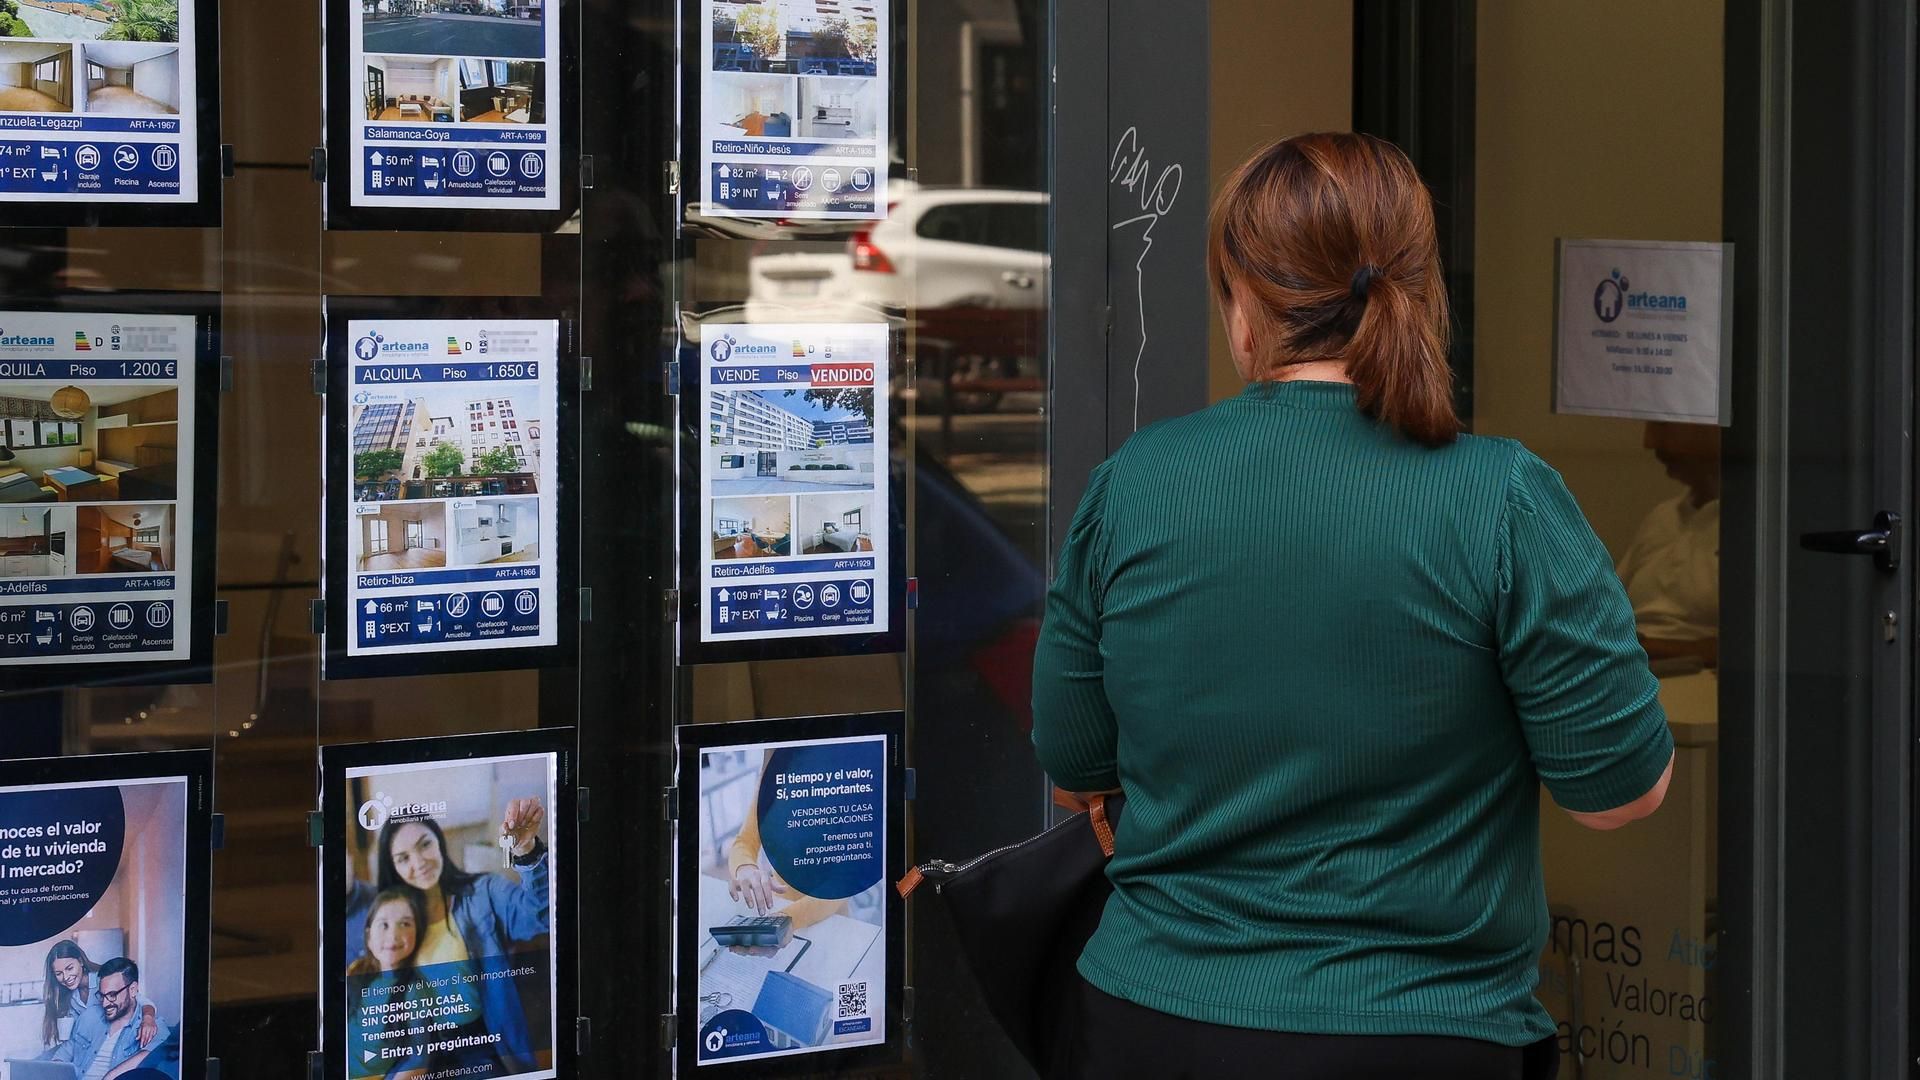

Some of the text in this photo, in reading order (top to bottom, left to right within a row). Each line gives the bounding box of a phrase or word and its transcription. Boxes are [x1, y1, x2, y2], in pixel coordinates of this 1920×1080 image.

[129, 121, 175, 129] ART-A-1967
[368, 128, 450, 140] Salamanca-Goya
[500, 132, 541, 140] ART-A-1969
[62, 147, 67, 157] 1
[715, 143, 791, 154] Retiro-Niño Jesús
[386, 156, 398, 166] 50
[441, 157, 446, 167] 1
[13, 168, 36, 178] EXT
[63, 170, 68, 180] 1
[732, 169, 744, 178] 82
[782, 170, 788, 179] 2
[114, 178, 139, 186] Piscina
[148, 180, 179, 188] Ascensor
[398, 177, 415, 187] INT
[441, 179, 446, 189] 1
[448, 181, 483, 189] Amueblado
[518, 184, 546, 192] Ascenso
[743, 188, 758, 198] INT
[782, 190, 787, 199] 1
[1627, 292, 1686, 309] arteana
[1, 335, 54, 345] arteana
[95, 337, 103, 347] D
[382, 341, 429, 351] arteana
[465, 342, 472, 351] D
[735, 344, 776, 353] arteana
[808, 345, 814, 354] D
[70, 364, 96, 376] Piso
[120, 363, 161, 376] 1.200
[164, 363, 175, 376] €
[363, 364, 536, 381] ALQUILA Piso 1.650 €
[718, 368, 873, 382] VENDE Piso VENDIDO
[834, 560, 871, 569] ART-V-1929
[496, 568, 536, 578] ART-A-1966
[714, 565, 775, 576] Retiro-Adelfas
[125, 579, 171, 588] ART-A-1965
[359, 575, 414, 587] Retiro-Ibiza
[732, 591, 748, 600] 109
[781, 588, 787, 598] 2
[380, 603, 392, 612] 66
[436, 601, 441, 610] 1
[58, 611, 63, 621] 1
[742, 610, 761, 620] EXT
[781, 609, 787, 619] 2
[822, 613, 840, 621] Garaje
[436, 622, 441, 631] 1
[476, 620, 508, 628] Calefacción
[8, 633, 31, 644] EXT
[58, 633, 62, 643] 1
[102, 633, 138, 641] Calefacción
[445, 631, 471, 639] Amueblar
[776, 768, 873, 785] El tiempo y el valor,
[776, 782, 873, 801] Sí, son importantes.
[390, 800, 447, 817] arteana
[792, 803, 873, 817] VENDEMOS TU CASA
[787, 814, 873, 828] SIN COMPLICACIONES
[47, 822, 60, 836] el
[64, 820, 102, 835] valor
[823, 832, 857, 842] Tenemos
[2, 839, 107, 859] de tu vivienda
[806, 842, 864, 855] propuesta para
[793, 852, 873, 866] Entra y pregúntanos.
[9, 860, 83, 879] mercado?
[11, 883, 74, 895] tu casa de forma
[12, 892, 89, 906] y sin complicaciones
[361, 988, 371, 997] El
[373, 983, 405, 997] tiempo
[408, 983, 413, 993] y
[416, 981, 424, 989] el
[426, 978, 449, 988] valor
[463, 974, 479, 984] son
[480, 966, 537, 981] importantes.
[362, 993, 463, 1016] VENDEMOS TU CASA
[362, 1004, 472, 1027] SIN COMPLICACIONES.
[362, 1021, 459, 1042] Tenemos una oferta.
[381, 1033, 501, 1059] Entra y pregúntanos
[411, 1062, 492, 1080] www.arteana.com
